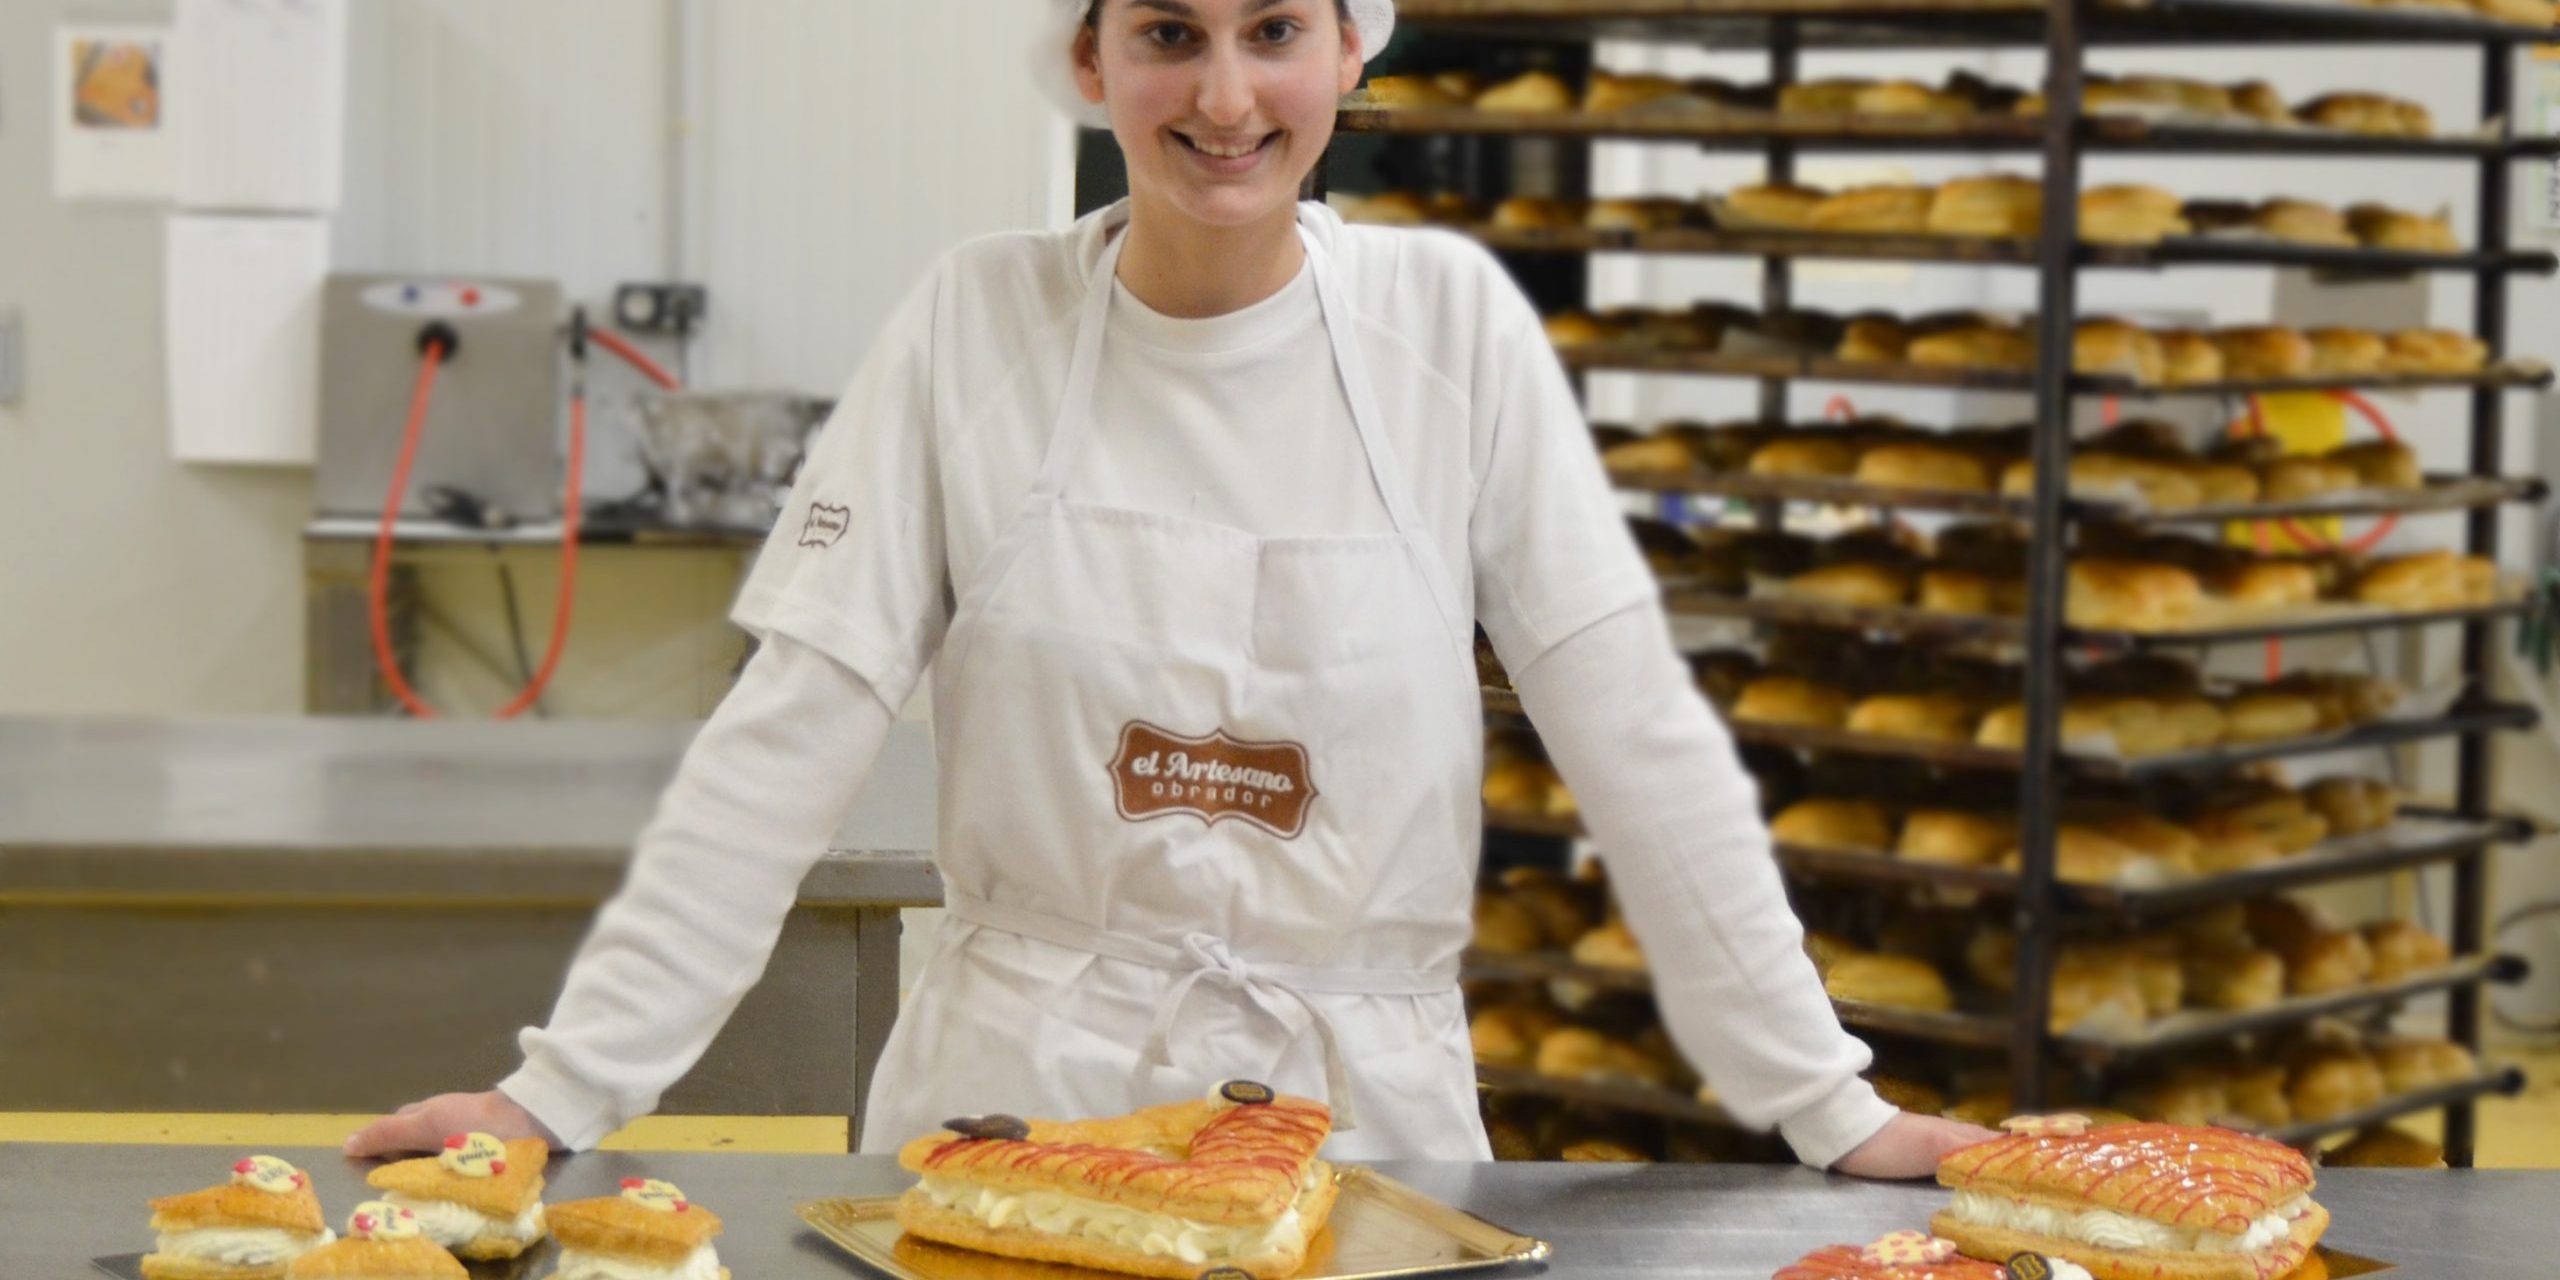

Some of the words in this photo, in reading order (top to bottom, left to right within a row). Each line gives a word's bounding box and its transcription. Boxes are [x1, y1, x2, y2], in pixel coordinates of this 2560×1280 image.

[1131, 751, 1160, 776] el
[1164, 752, 1294, 792] Artesano
[1152, 781, 1273, 807] obrador
